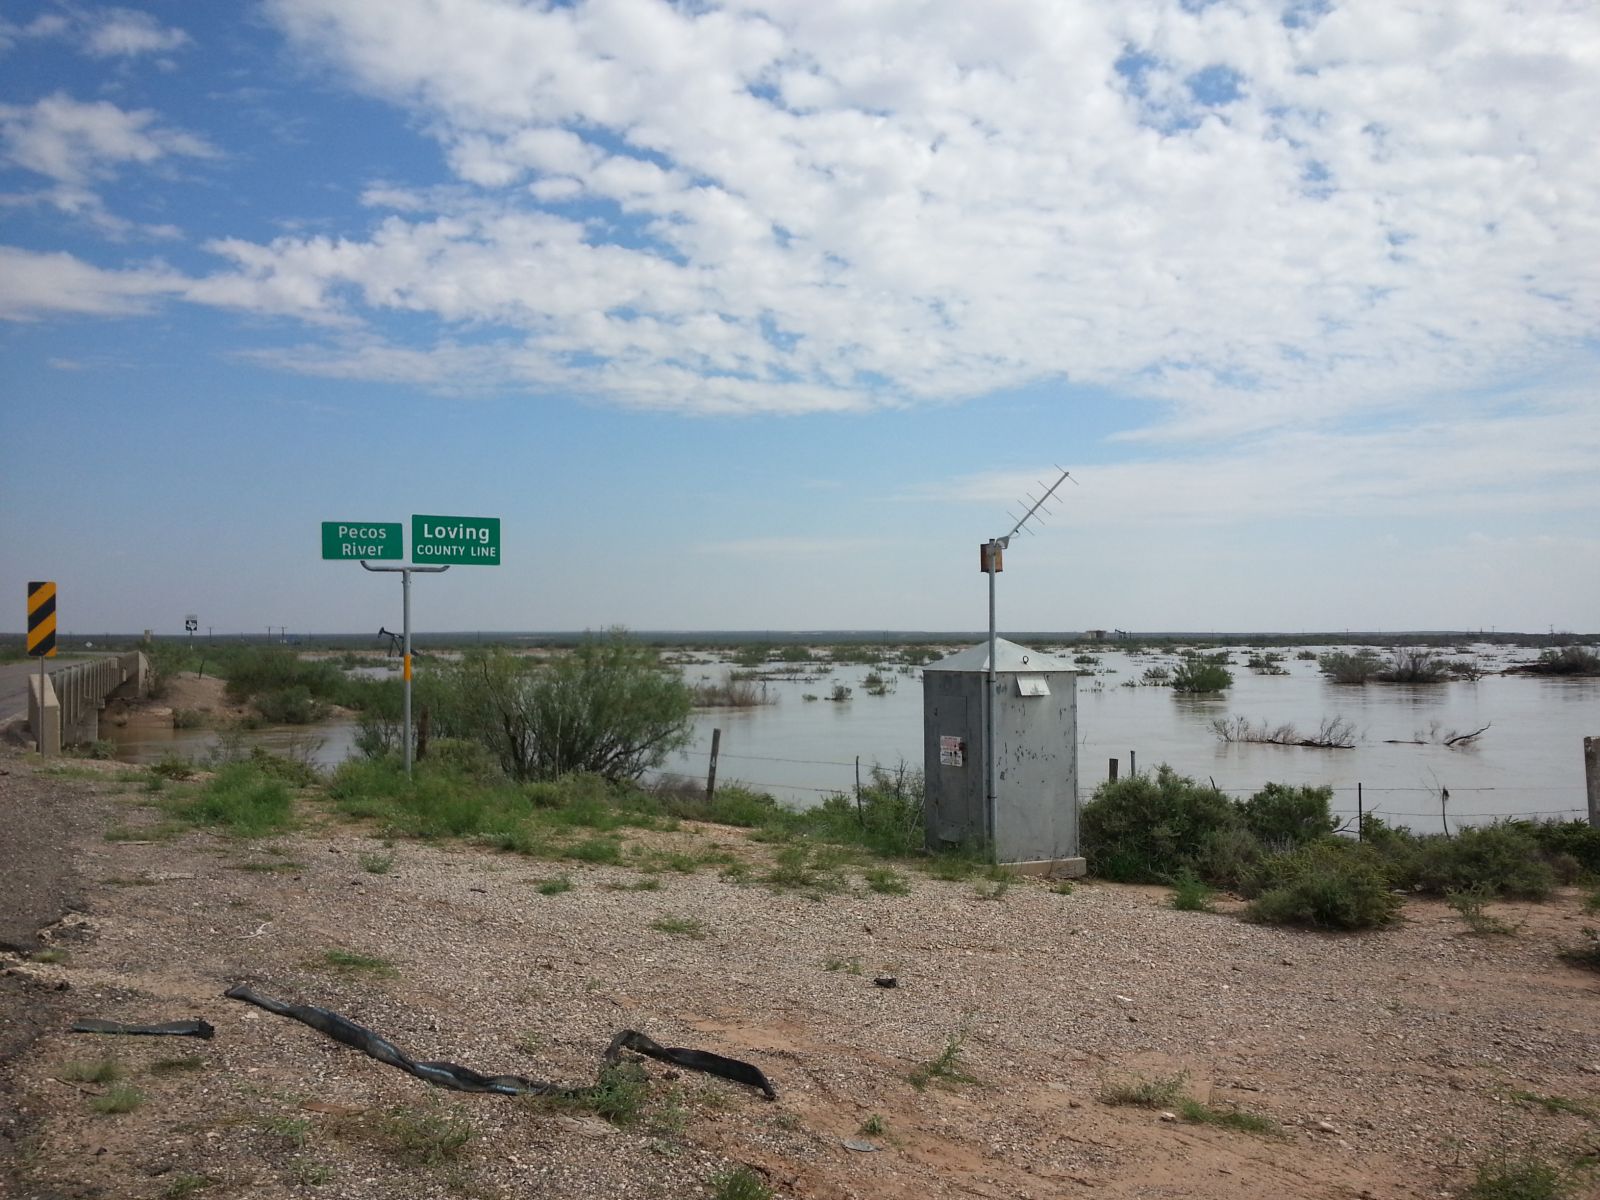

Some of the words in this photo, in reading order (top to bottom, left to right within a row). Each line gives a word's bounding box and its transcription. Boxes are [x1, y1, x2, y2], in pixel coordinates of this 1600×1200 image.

[338, 525, 387, 539] Pecos
[423, 523, 490, 544] Loving
[342, 542, 384, 556] River
[416, 544, 465, 556] COUNTY
[470, 546, 497, 557] LINE
